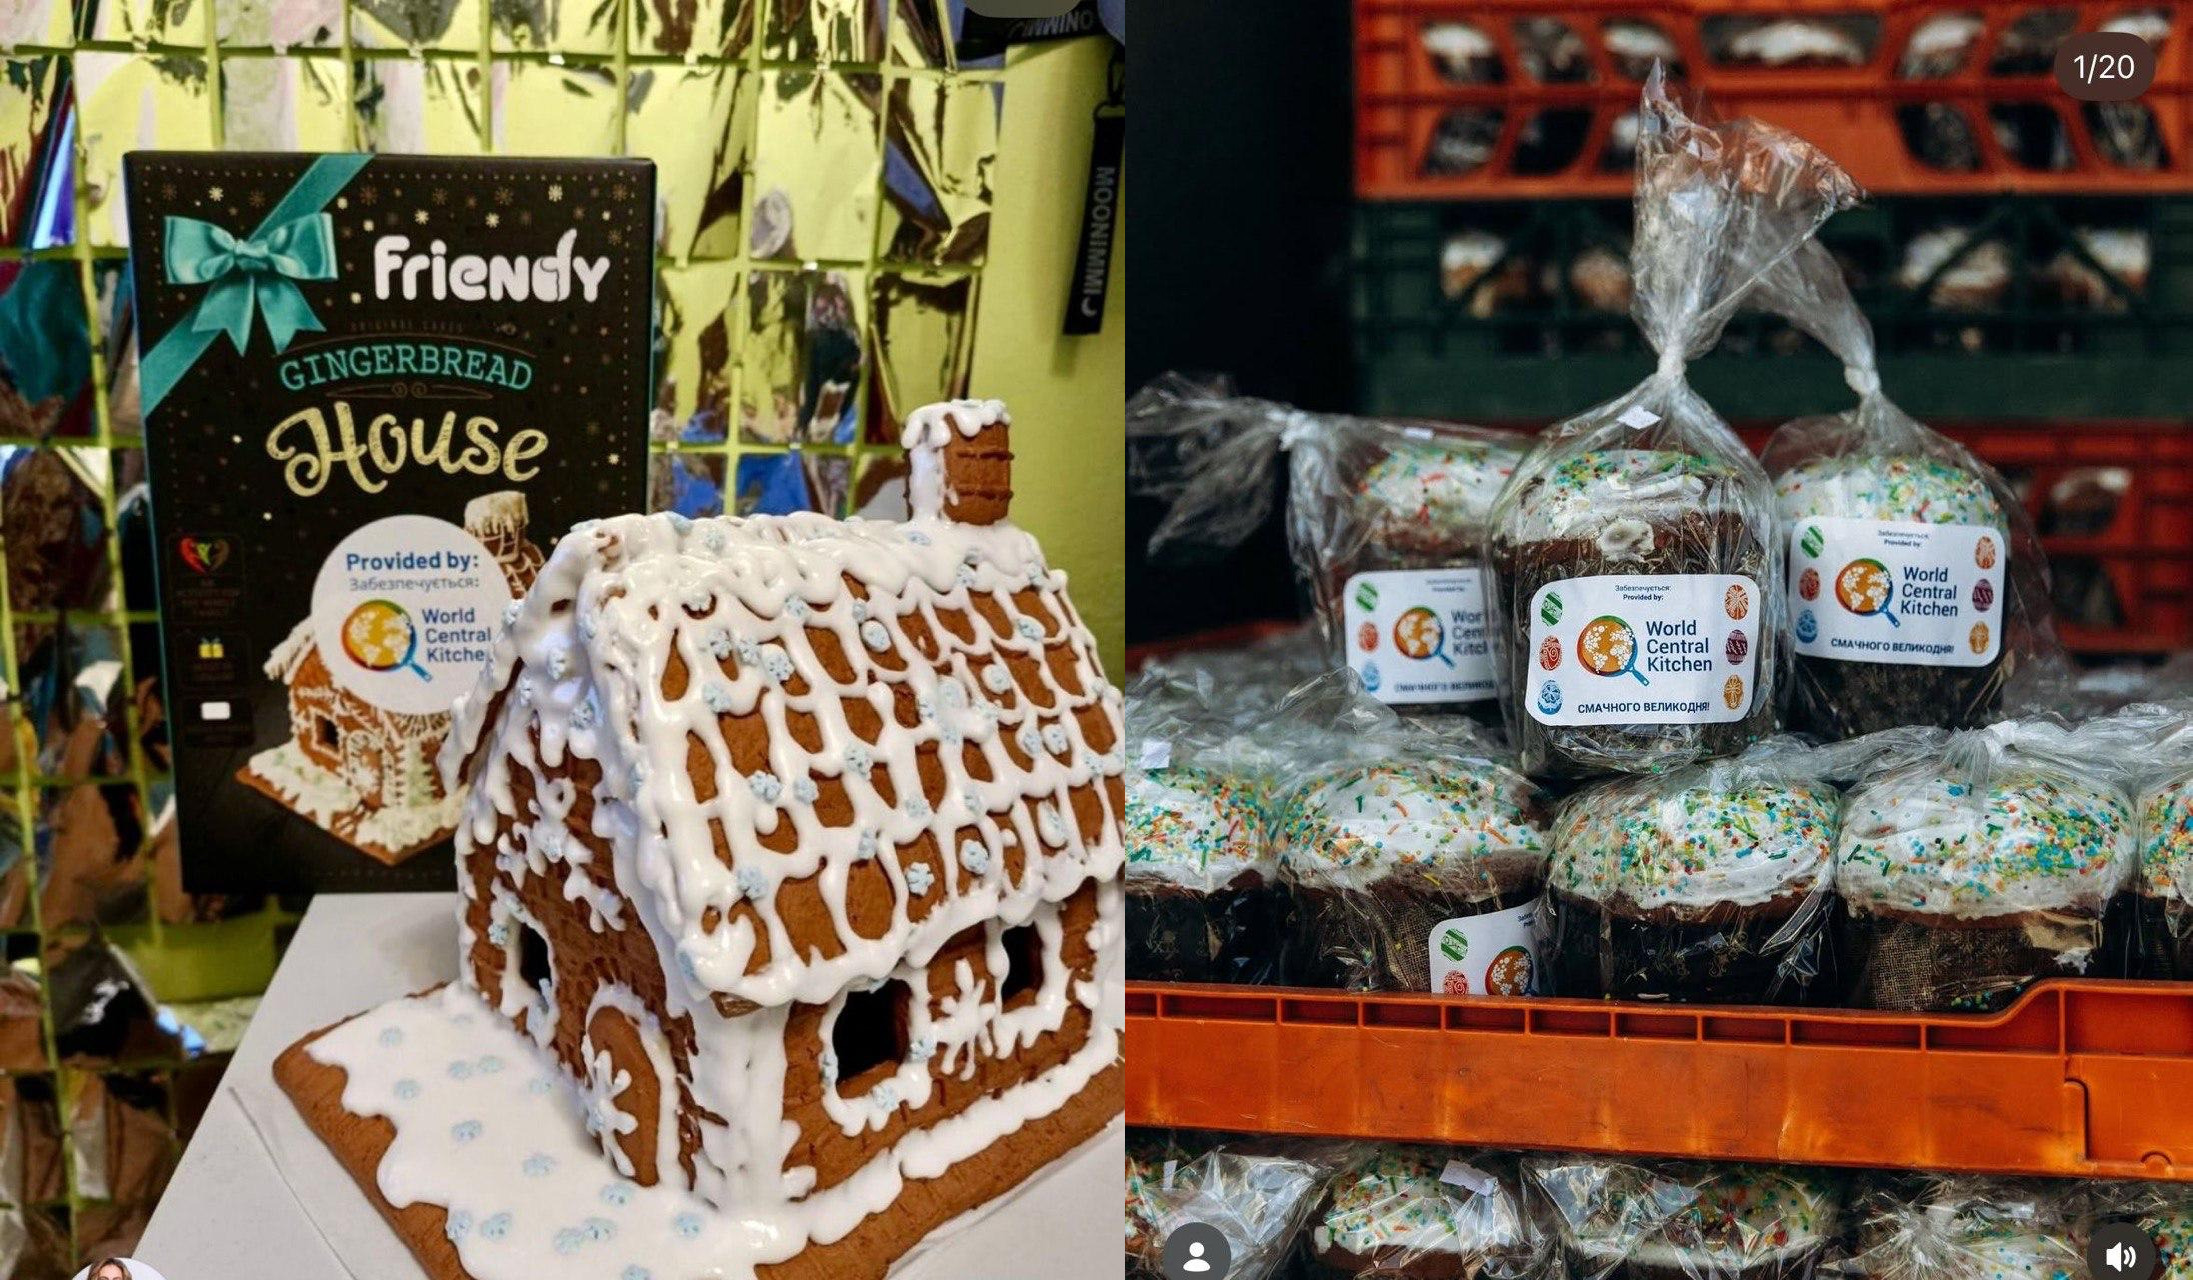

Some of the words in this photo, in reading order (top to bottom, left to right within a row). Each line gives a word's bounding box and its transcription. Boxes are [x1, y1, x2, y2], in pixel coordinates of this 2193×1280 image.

[279, 343, 533, 392] GINGERBREAD
[265, 401, 550, 498] House
[346, 551, 441, 570] Provided
[446, 551, 479, 573] by:
[1903, 566, 1948, 582] World
[1622, 593, 1652, 601] Provided
[1653, 593, 1664, 602] by:
[1902, 583, 1958, 600] Central
[422, 606, 475, 624] World
[1900, 600, 1959, 617] Kitchen
[425, 627, 491, 643] Central
[1646, 619, 1697, 636] World
[1647, 637, 1709, 655] Central
[1830, 637, 1890, 652] СМАЧНОГО
[427, 646, 493, 663] Kitche
[1647, 656, 1713, 673] Kitchen
[1577, 701, 1641, 714] СМАЧНОГО
[1643, 701, 1710, 714] ВЕЛИКОДНЯ!
